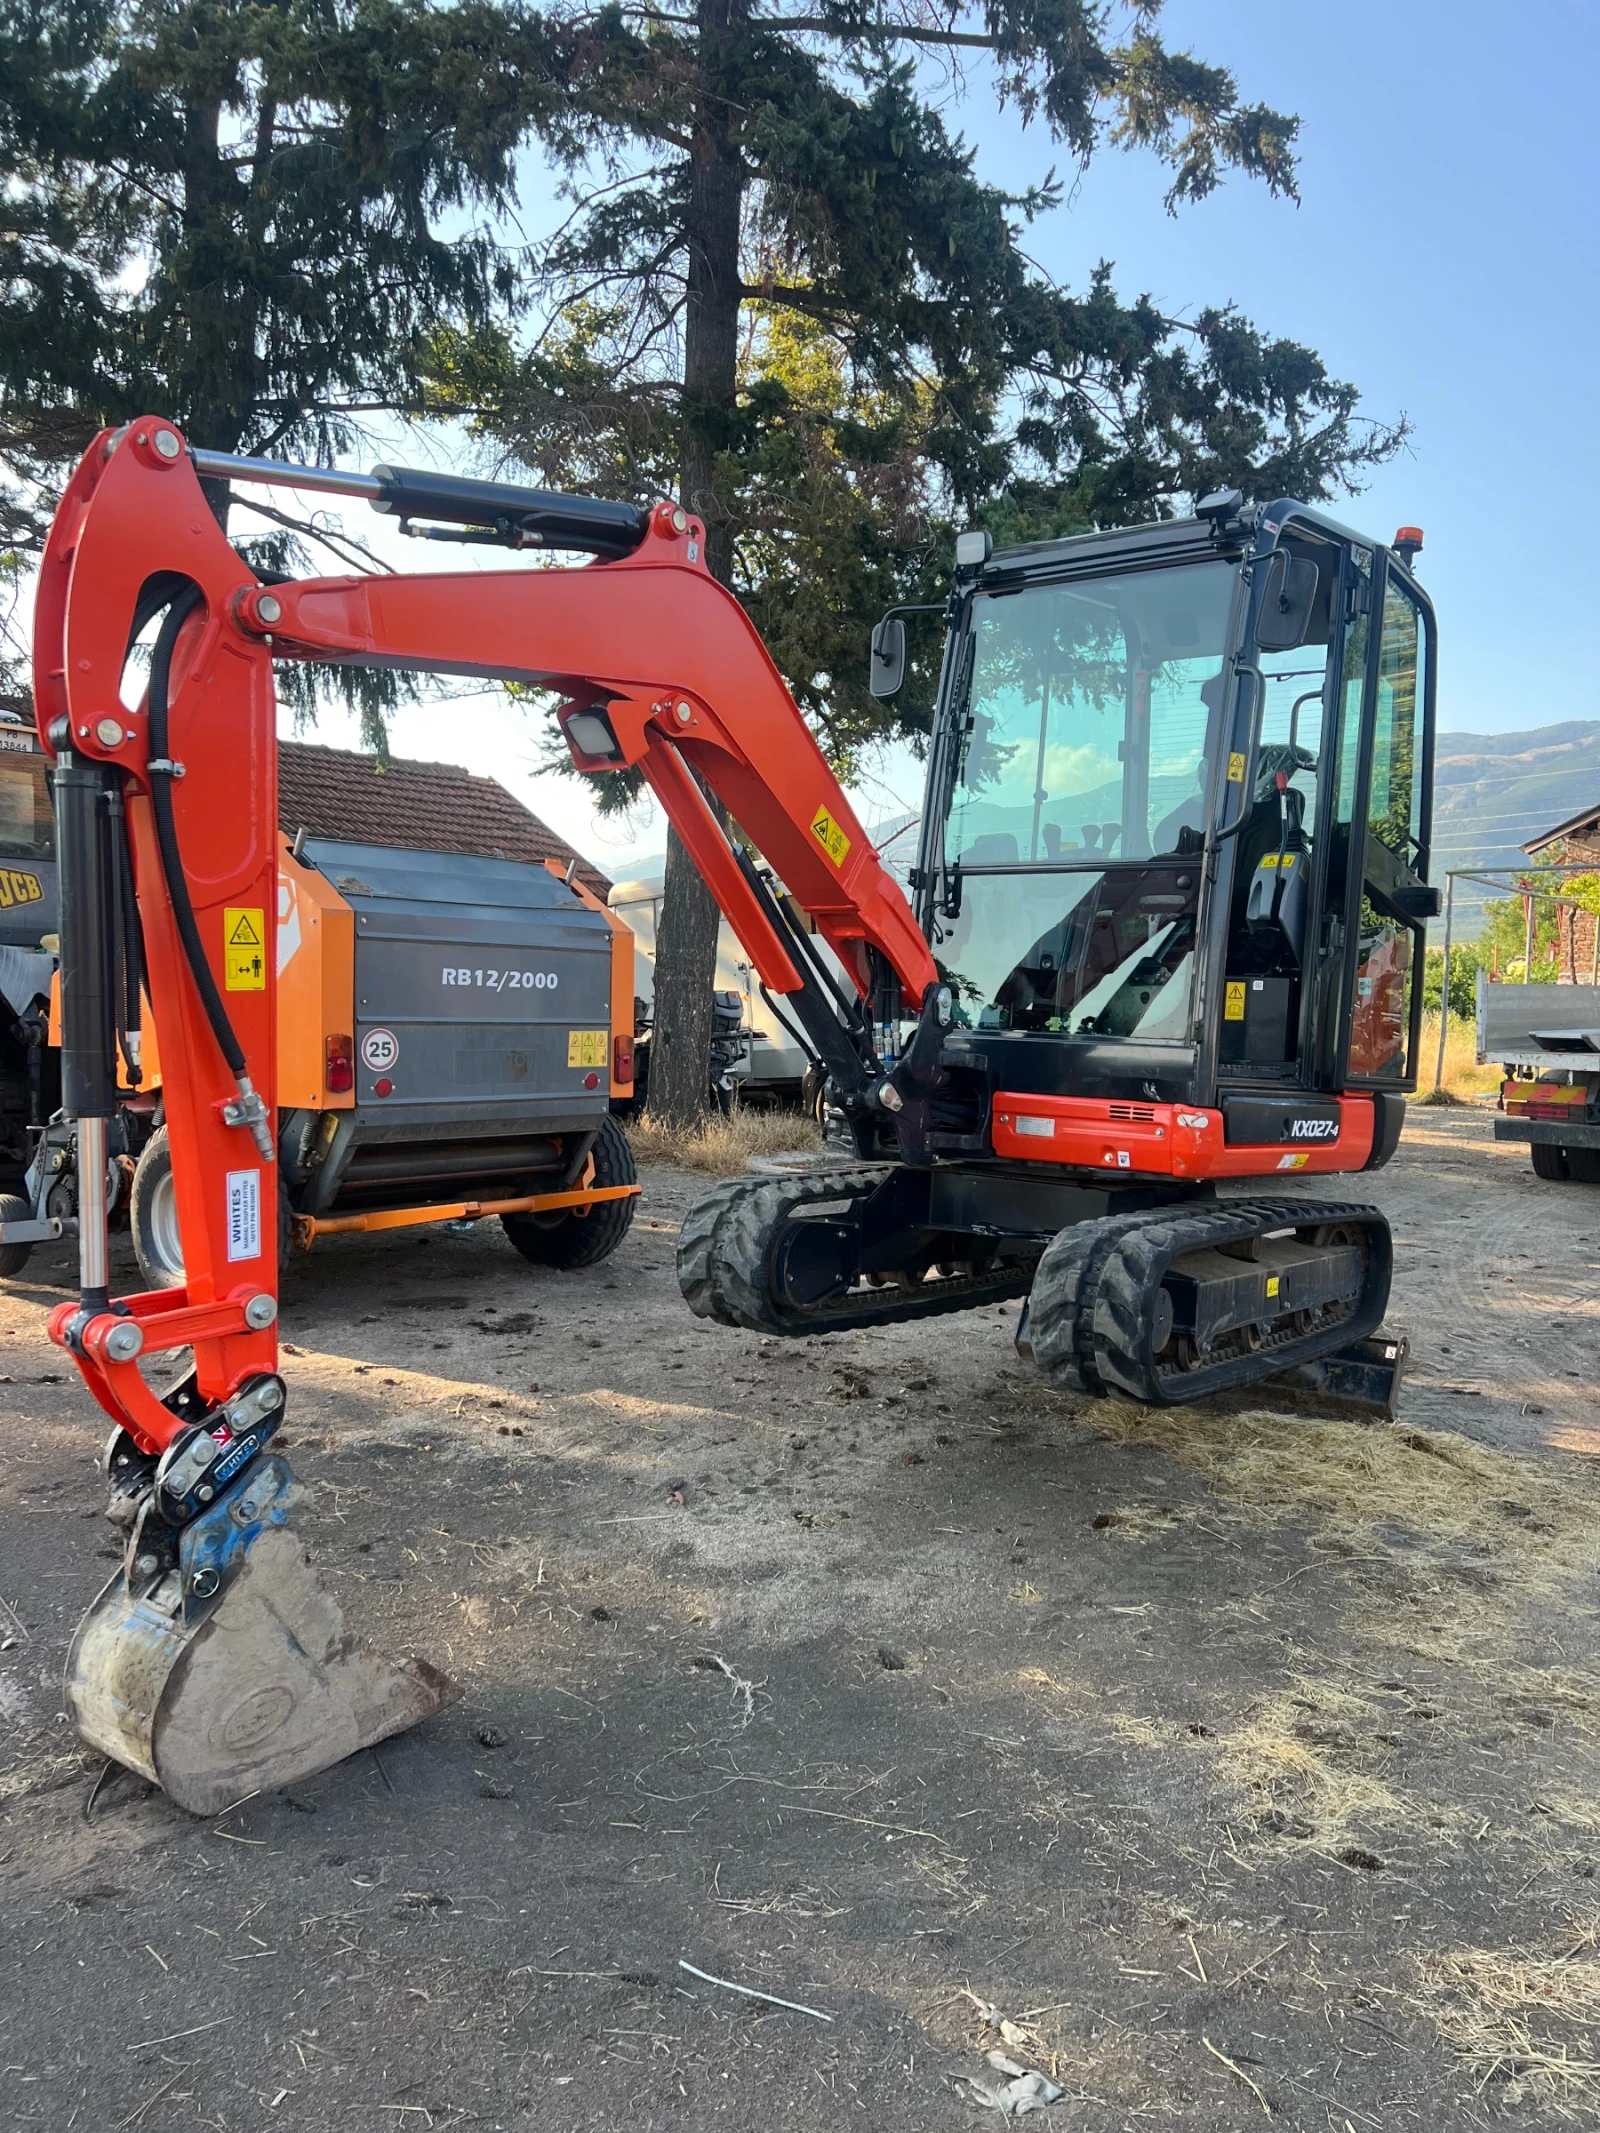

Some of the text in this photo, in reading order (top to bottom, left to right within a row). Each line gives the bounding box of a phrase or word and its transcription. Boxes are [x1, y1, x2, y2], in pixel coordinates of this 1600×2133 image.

[0, 870, 41, 907] JCB
[369, 1041, 392, 1058] 25
[1291, 1120, 1339, 1137] KX027-4
[232, 1189, 241, 1244] WHITES
